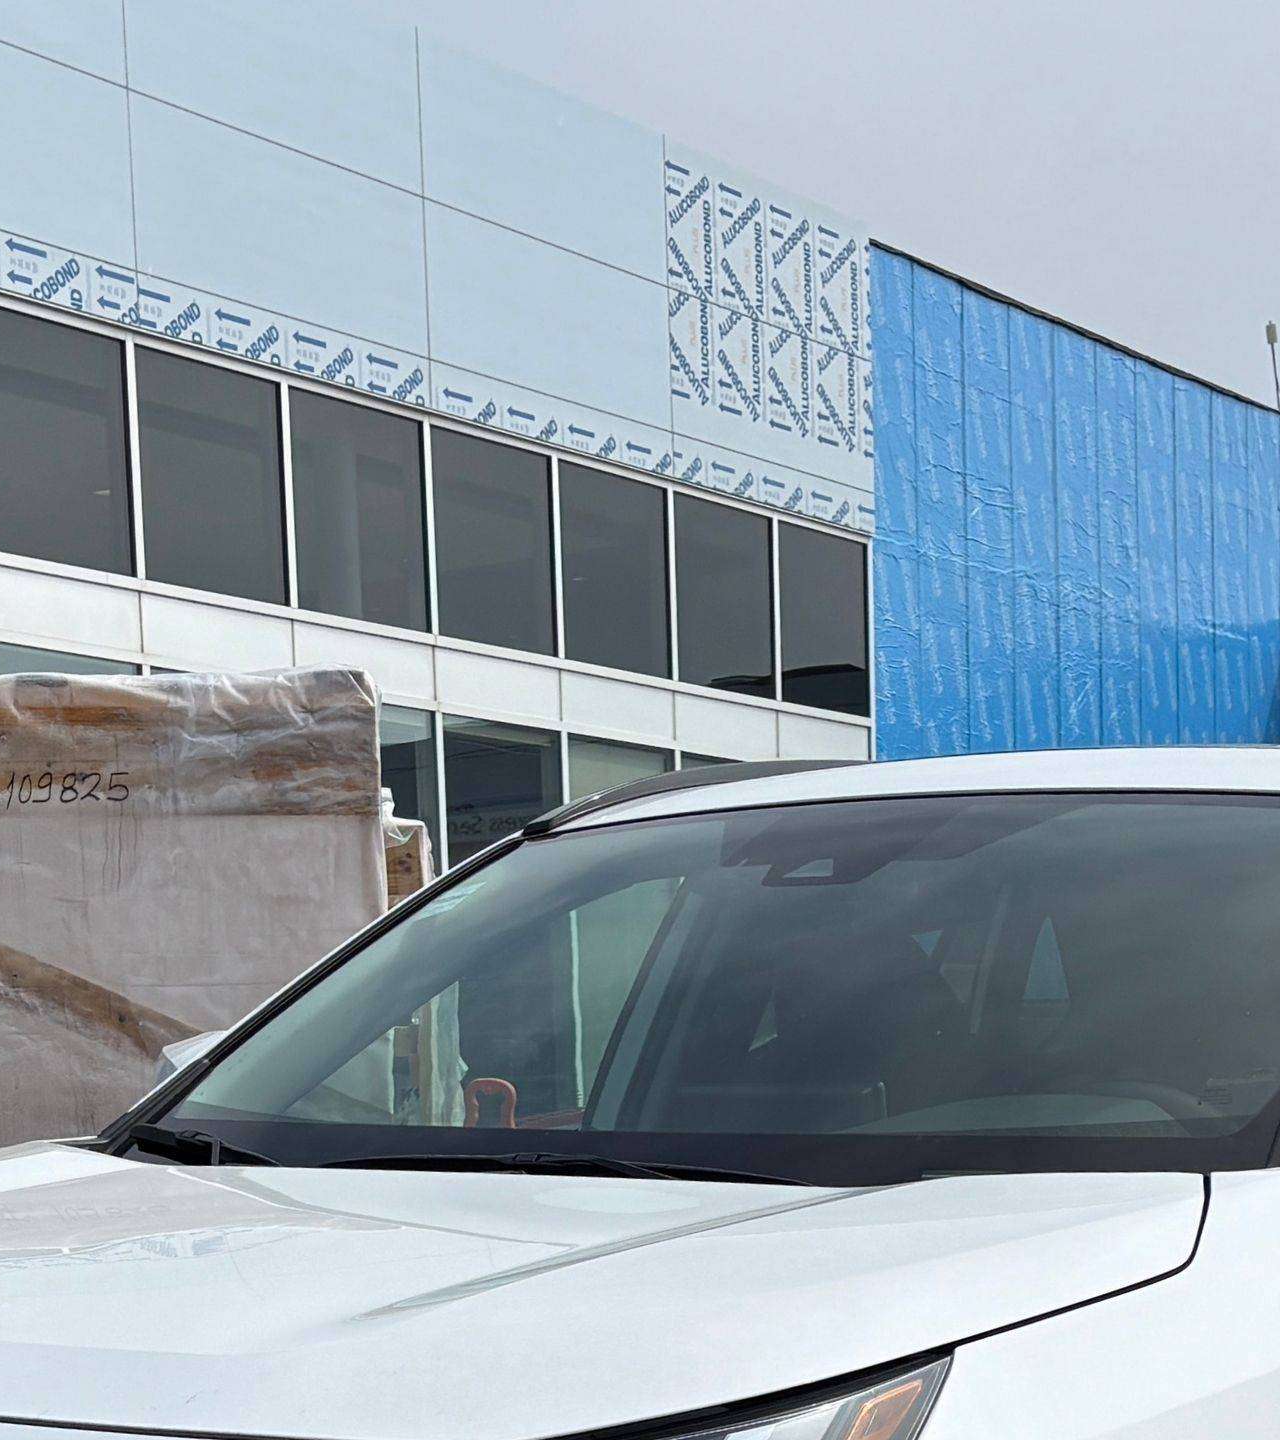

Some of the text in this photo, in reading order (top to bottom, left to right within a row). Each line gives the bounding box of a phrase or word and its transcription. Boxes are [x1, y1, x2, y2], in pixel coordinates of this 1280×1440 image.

[703, 200, 713, 297] ALUCOBOND
[755, 221, 764, 316] ALUCOBOND
[803, 242, 813, 334] ALUCOBOND
[849, 261, 858, 350] ALUCOBOND
[7, 771, 130, 809] 109825
